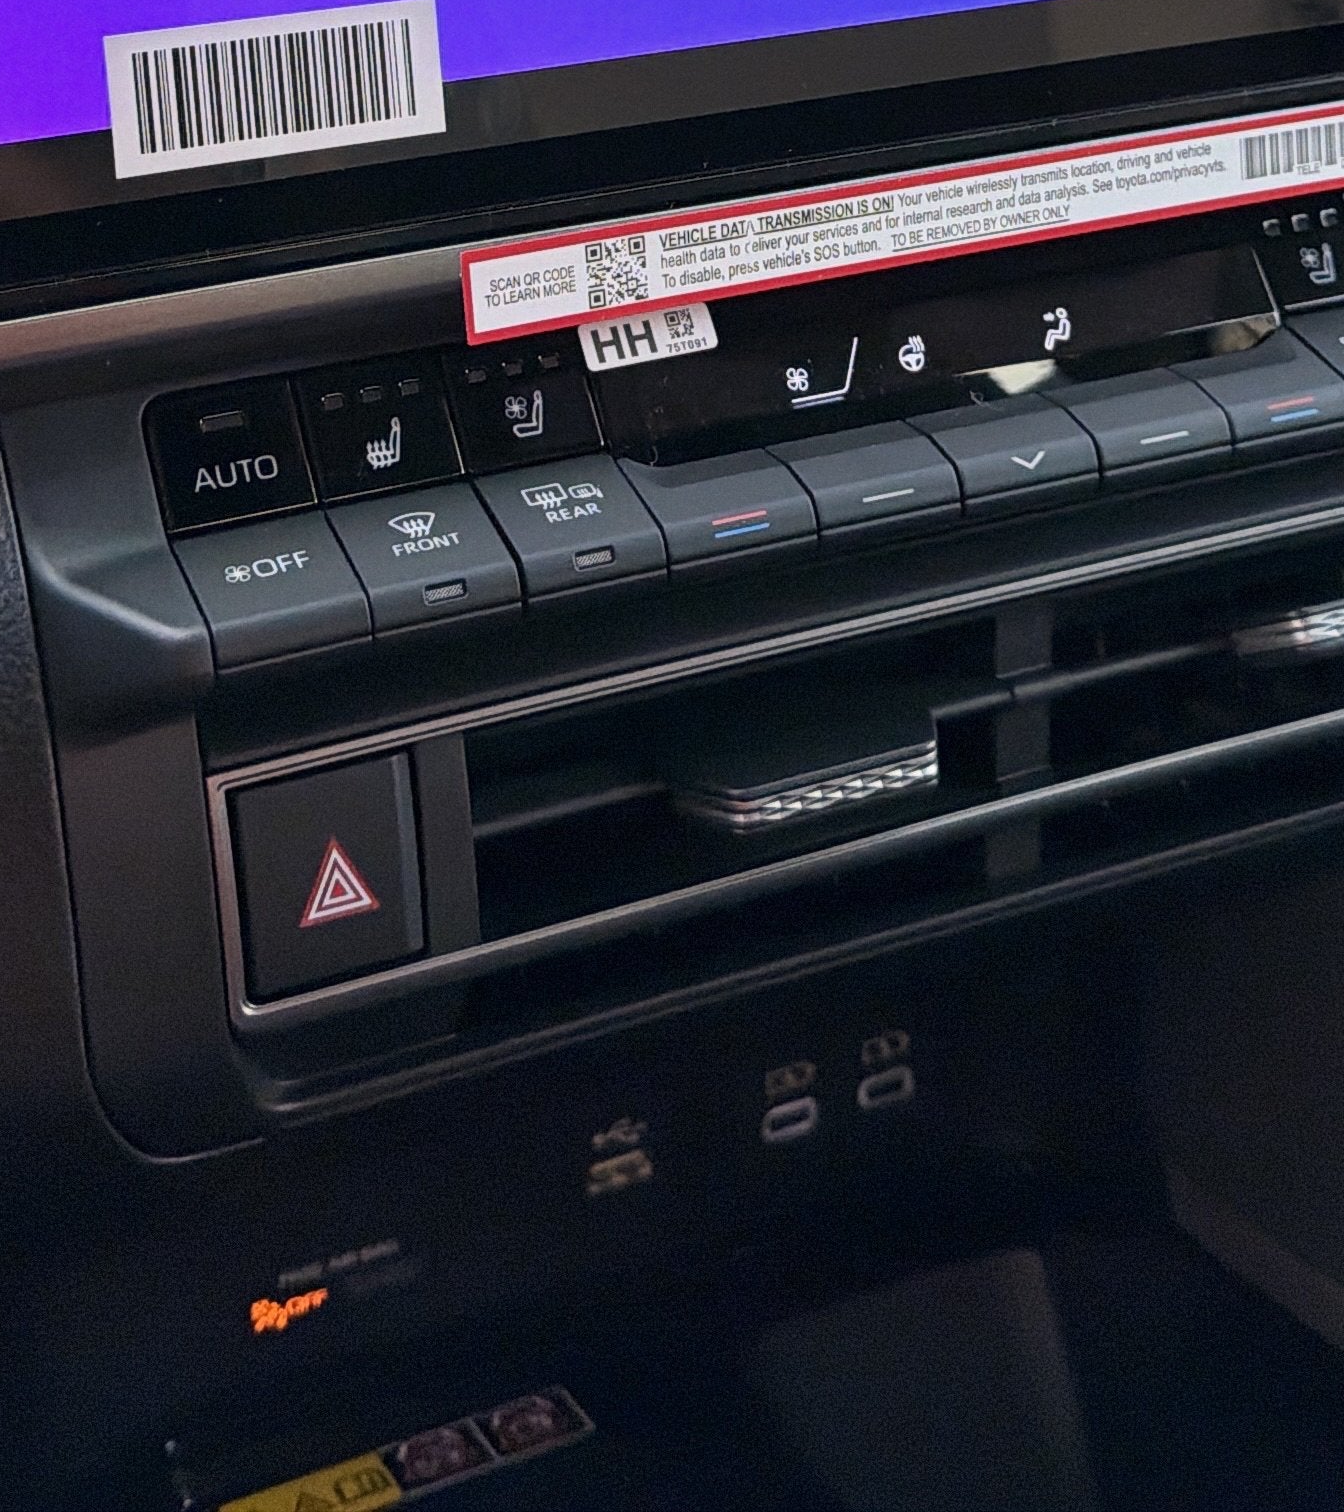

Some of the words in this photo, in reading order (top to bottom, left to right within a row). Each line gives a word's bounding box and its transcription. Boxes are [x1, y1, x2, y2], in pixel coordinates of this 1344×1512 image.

[659, 224, 716, 248] VEHICLE
[721, 220, 755, 238] DATA
[757, 201, 853, 231] TRANSMISSION
[857, 199, 868, 214] IS
[872, 195, 894, 211] ON!
[897, 192, 922, 207] Your
[926, 184, 963, 202] vehicle
[966, 175, 1018, 196] wirelessly
[1021, 167, 1068, 186] transmits
[1071, 160, 1114, 178] location,
[1117, 154, 1151, 170] driving
[1154, 148, 1173, 163] and
[1176, 142, 1212, 159] vehicle
[661, 249, 696, 269] health
[700, 246, 725, 262] data
[730, 243, 740, 256] to
[785, 232, 809, 251] your
[813, 222, 858, 242] services
[862, 217, 882, 233] and
[885, 215, 900, 229] for
[903, 206, 942, 226] internal
[946, 198, 992, 218] research
[996, 193, 1015, 210] and
[1018, 190, 1041, 205] data
[1044, 182, 1089, 202] analysis.
[1092, 178, 1112, 193] See
[662, 273, 676, 288] To
[680, 266, 725, 286] disable,
[728, 260, 759, 280] press
[763, 249, 811, 271] vehicle's
[814, 243, 840, 262] SOS
[843, 239, 881, 256] button.
[891, 232, 906, 248] TO
[909, 229, 924, 244] BE
[927, 219, 981, 241] REMOVED
[984, 216, 998, 232] BY
[1000, 209, 1041, 229] OWNER
[1042, 204, 1070, 221] ONLY
[485, 292, 501, 308] TO
[503, 286, 541, 305] LEARN
[543, 279, 577, 297] MORE
[489, 275, 521, 293] SCAN
[523, 272, 541, 286] QR
[543, 265, 576, 283] CODE
[590, 319, 659, 364] HH
[193, 456, 279, 495] AUTO
[545, 500, 601, 524] REAR
[391, 531, 460, 558] FRONT
[251, 550, 310, 579] OFF
